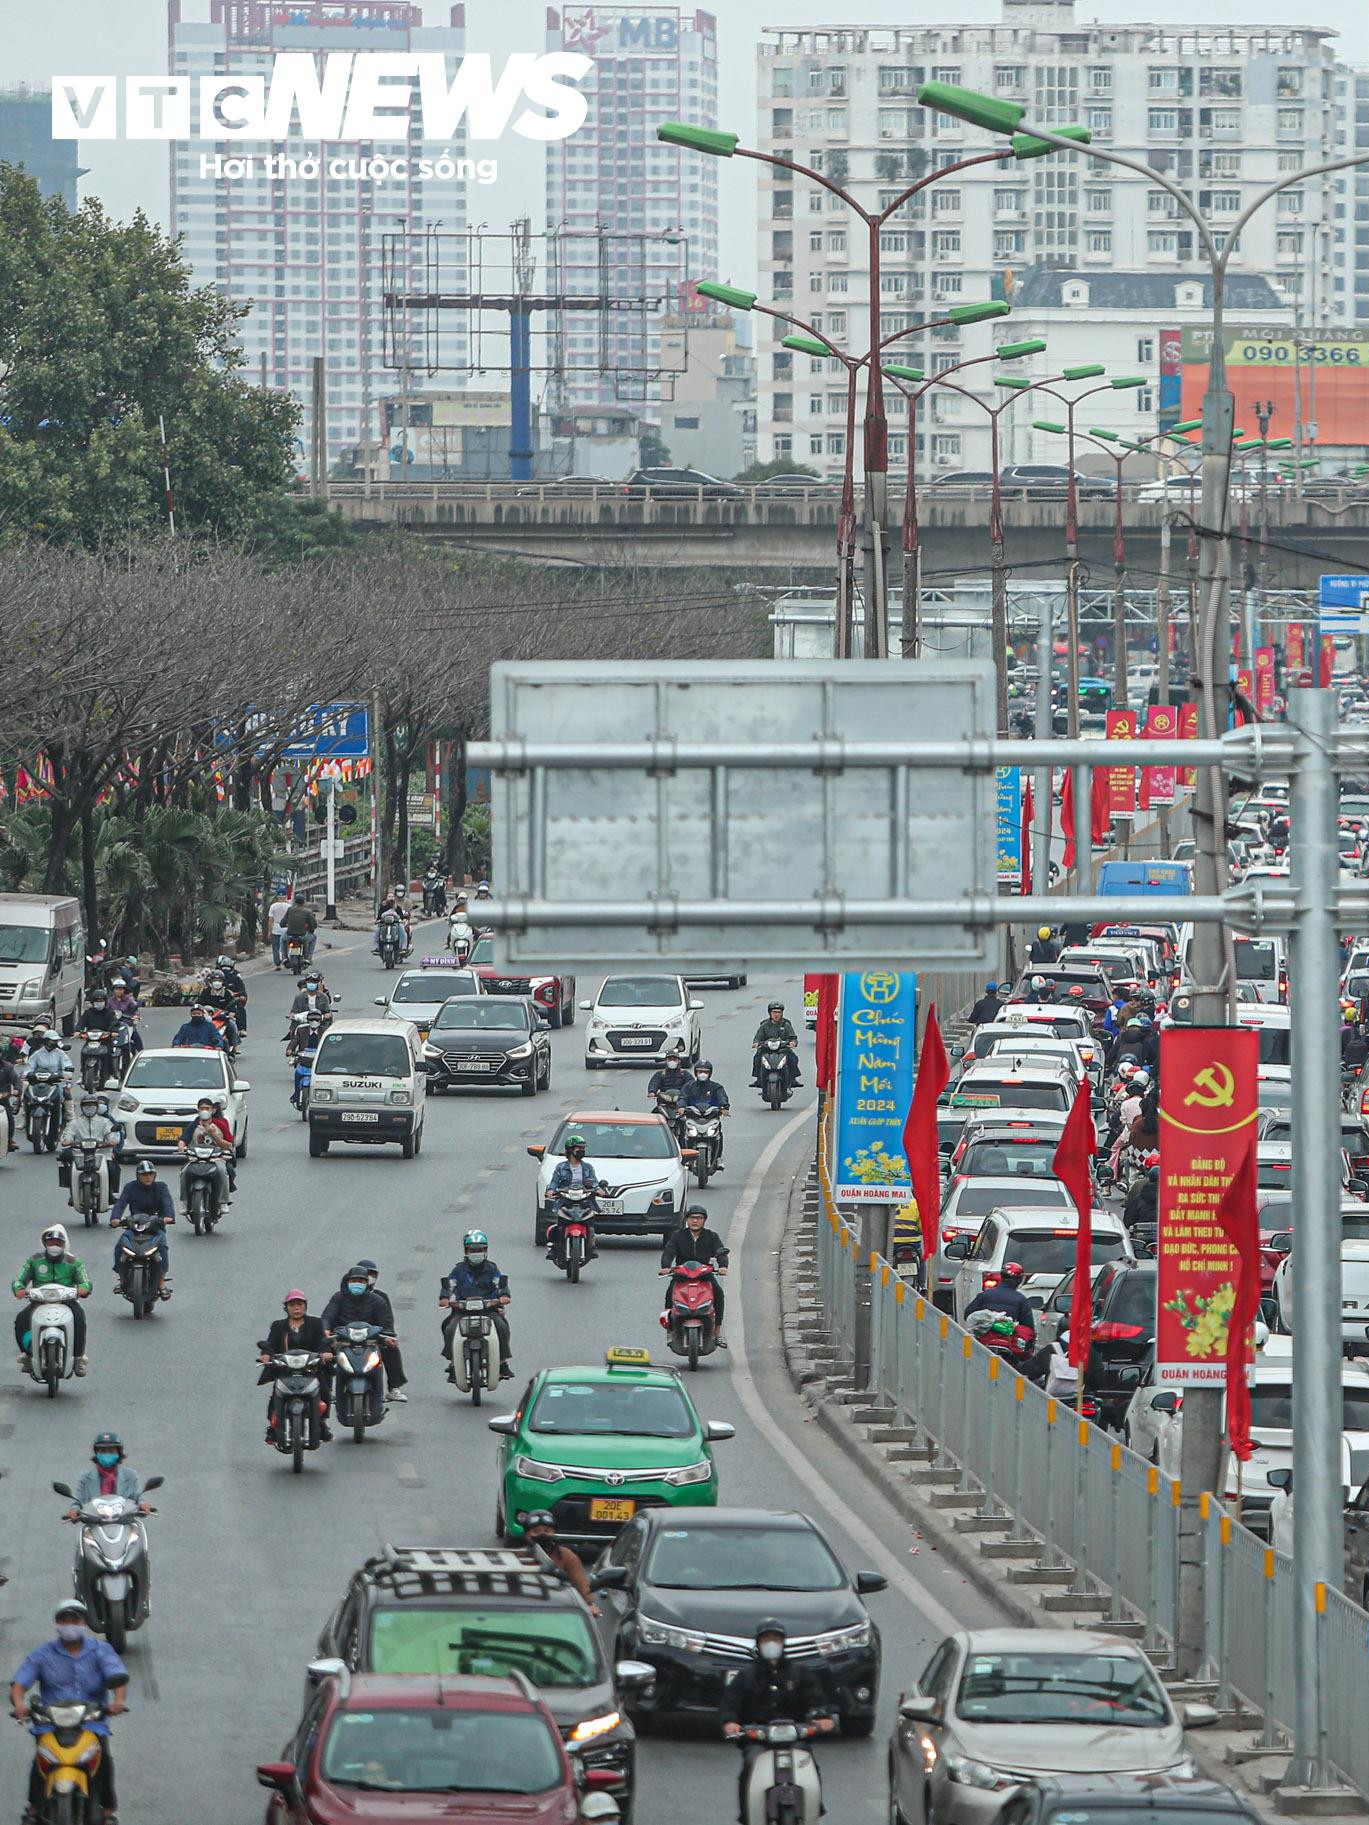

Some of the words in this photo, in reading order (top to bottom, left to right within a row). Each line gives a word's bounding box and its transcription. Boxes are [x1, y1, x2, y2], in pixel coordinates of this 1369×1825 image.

[619, 17, 678, 48] MB
[1243, 345, 1289, 361] 090
[1299, 346, 1360, 363] 3366
[851, 1008, 906, 1027] Chúc
[342, 1080, 383, 1089] SUZUKI
[856, 1099, 897, 1111] 2024
[1167, 1174, 1178, 1187] VÀ
[1180, 1173, 1202, 1187] NHÂN
[1203, 1174, 1220, 1187] DÂN
[840, 1188, 862, 1199] QUẬN
[863, 1187, 890, 1198] HOÀNG
[891, 1188, 907, 1199] MAI
[1190, 1190, 1207, 1204] SỨC
[1187, 1210, 1210, 1223] MẠNH
[1163, 1224, 1174, 1237] VÀ
[1175, 1224, 1192, 1238] LÀM
[1193, 1226, 1213, 1238] THEO
[1163, 1243, 1180, 1257] ĐẠO
[1201, 1243, 1228, 1255] PHONG
[1180, 1257, 1190, 1272] HỒ
[1192, 1257, 1206, 1272] CHÍ
[1207, 1259, 1229, 1272] MINH
[1161, 1367, 1189, 1381] QUẬN
[1192, 1366, 1227, 1380] HOÀNG
